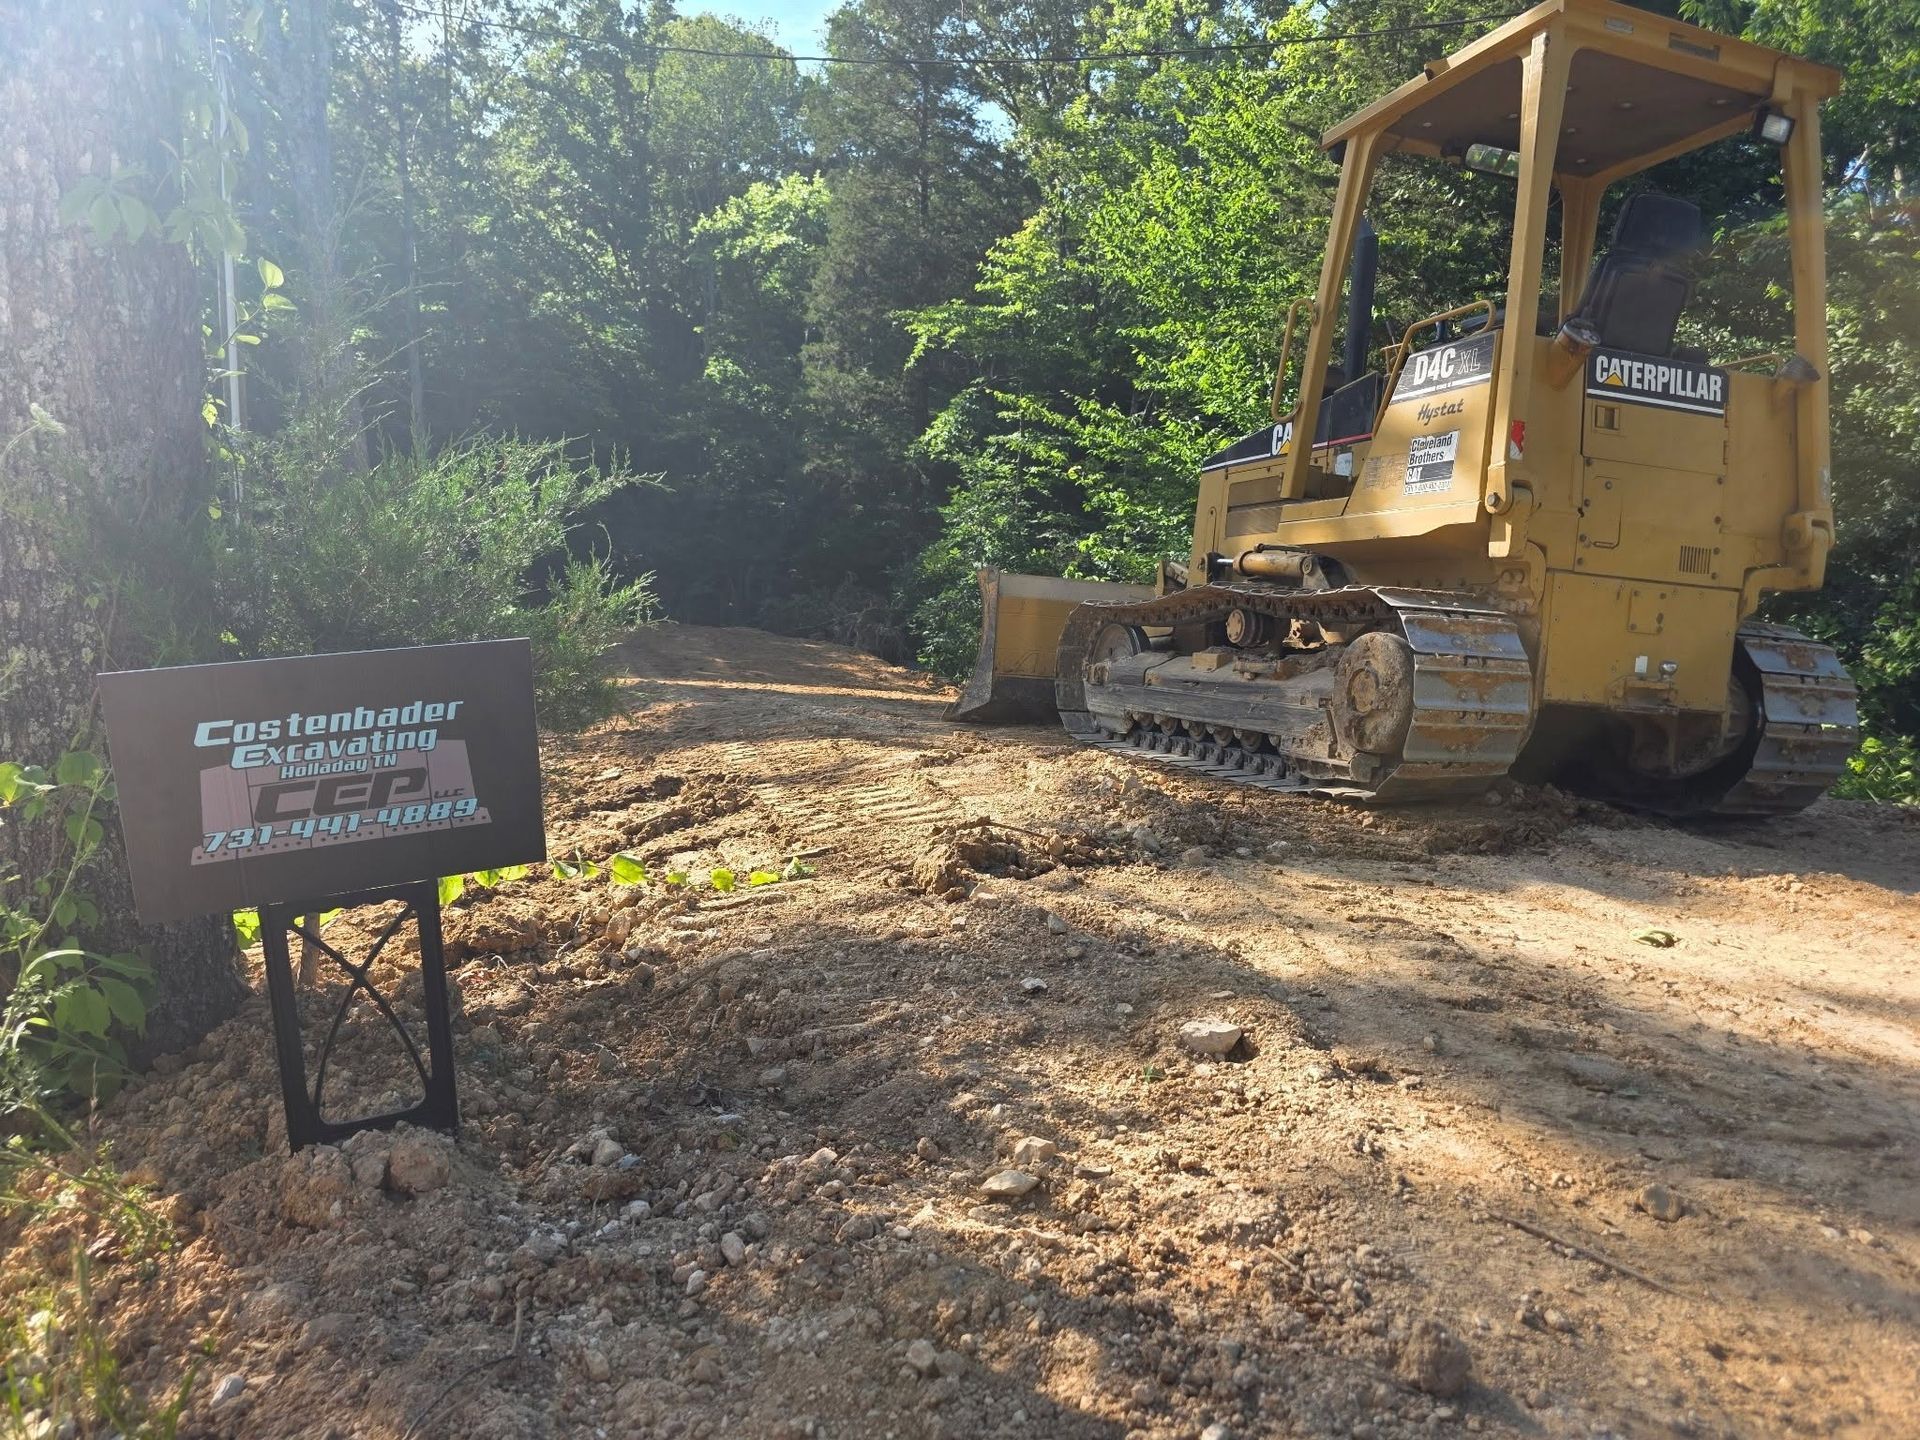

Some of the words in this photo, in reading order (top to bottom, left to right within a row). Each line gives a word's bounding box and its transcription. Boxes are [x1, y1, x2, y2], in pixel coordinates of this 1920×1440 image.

[1413, 348, 1456, 386] D4C
[1458, 348, 1480, 375] XL
[1596, 355, 1722, 402] CATERPILLAR
[1417, 399, 1465, 426] Hystat
[1409, 451, 1445, 465] Brothers
[1411, 434, 1453, 453] Cleveland
[194, 700, 464, 747] Costenbader
[230, 728, 438, 770] Excavating
[280, 759, 368, 780] Holladay
[370, 753, 397, 768] TN
[254, 767, 428, 823] CEP
[203, 798, 478, 854] 731-441-4889
